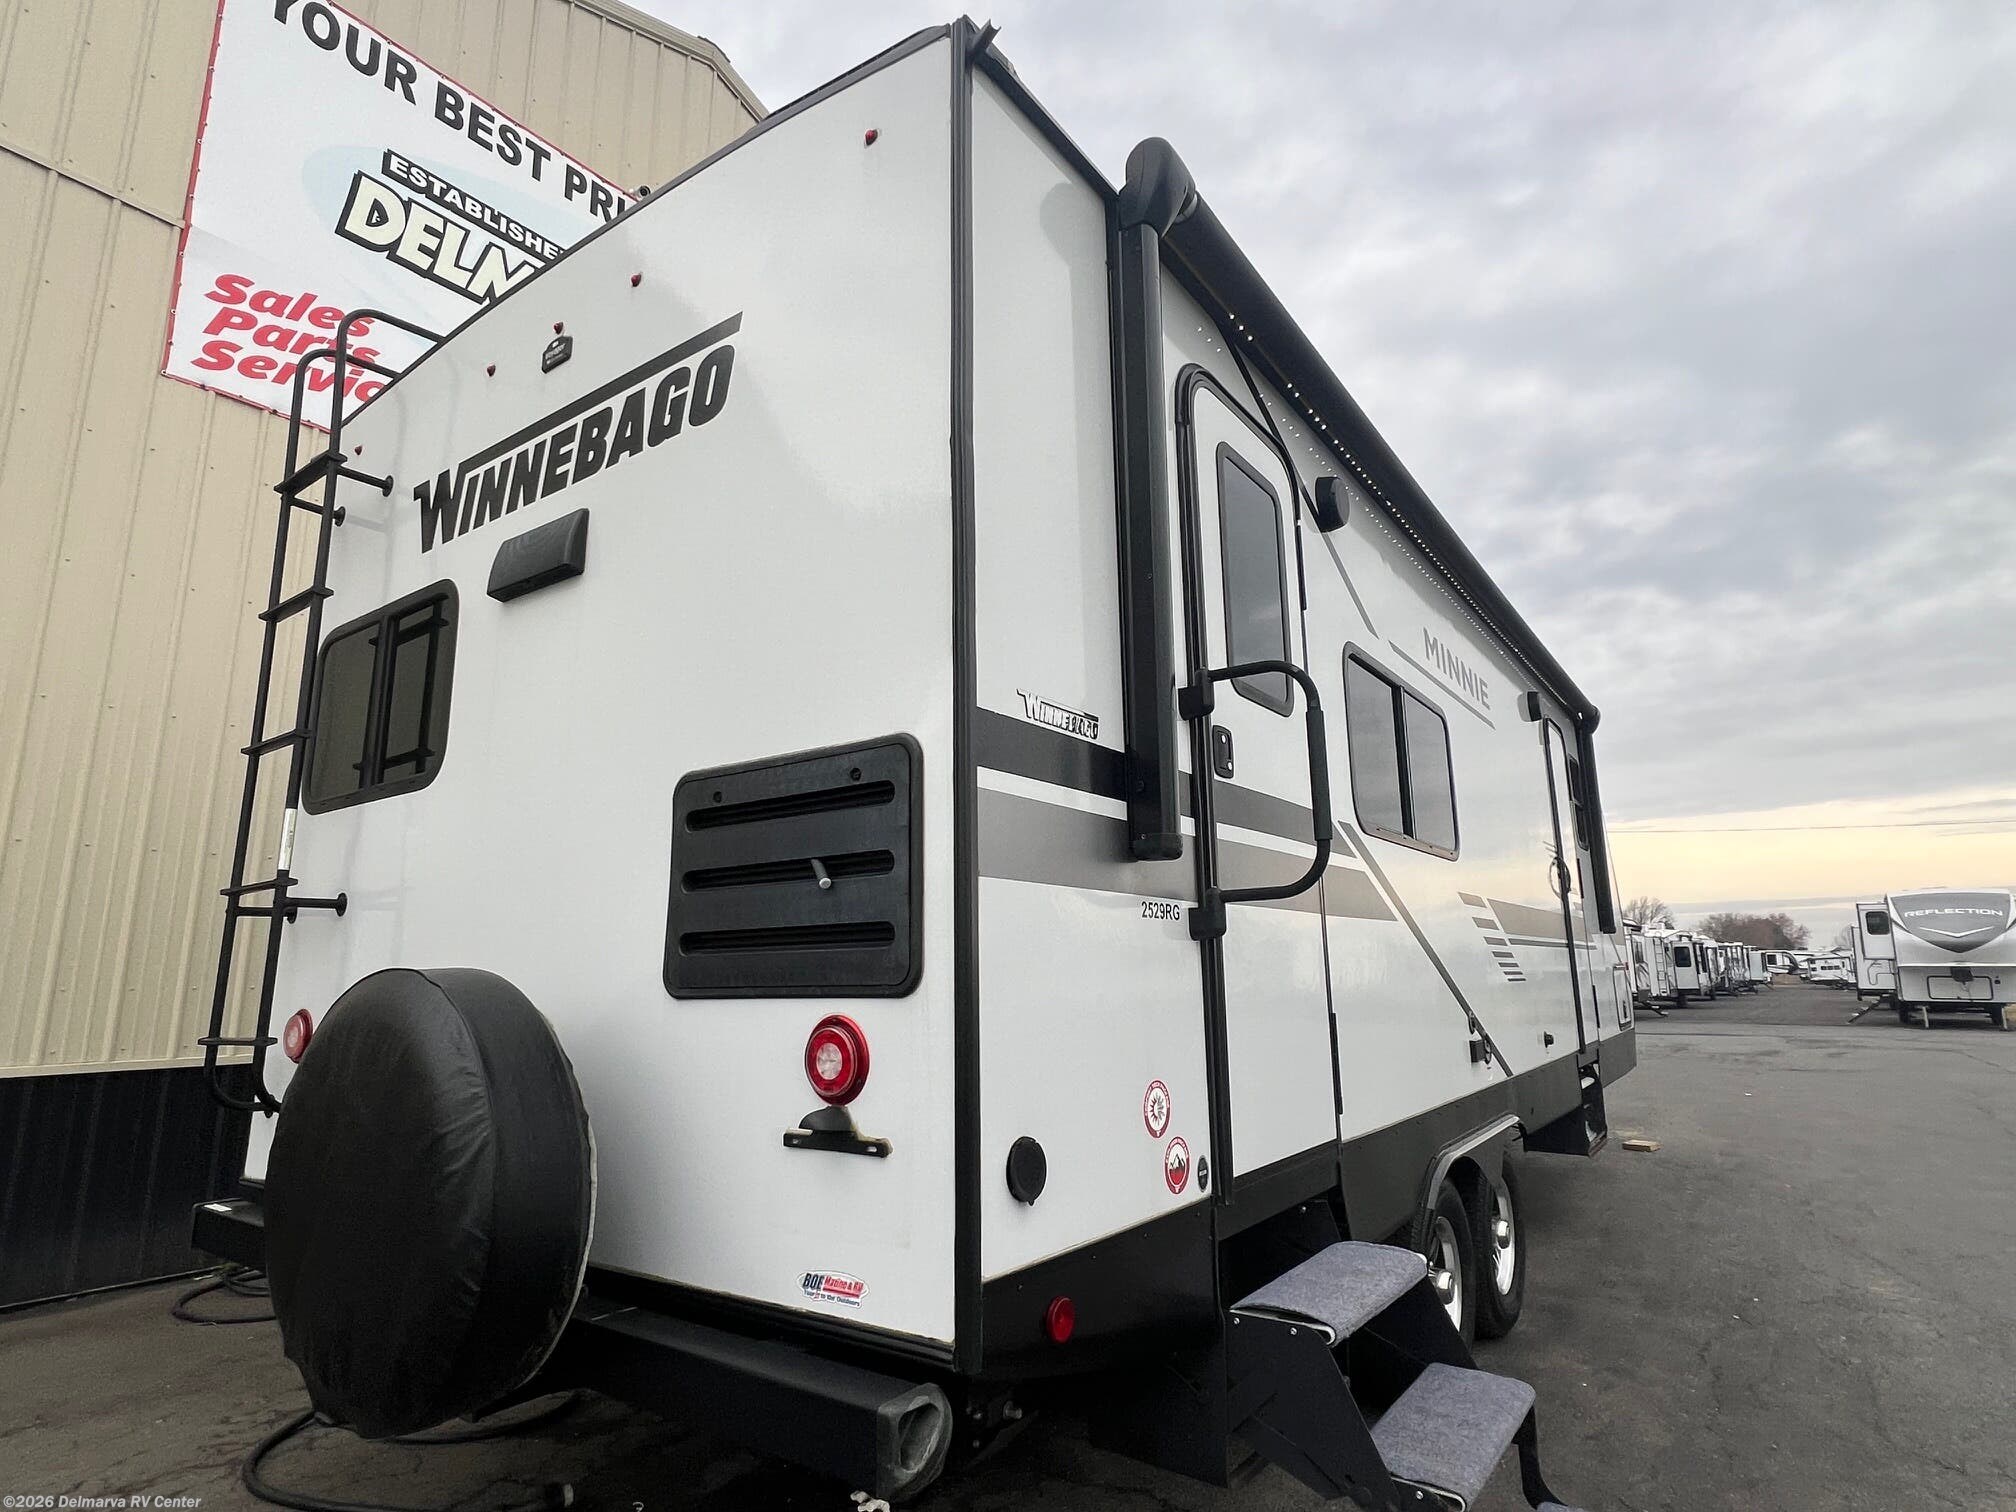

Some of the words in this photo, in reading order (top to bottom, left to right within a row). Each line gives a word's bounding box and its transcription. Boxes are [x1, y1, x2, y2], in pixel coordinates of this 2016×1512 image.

[435, 81, 551, 182] BEST
[203, 307, 381, 365] Parts
[204, 274, 375, 337] Sales
[413, 342, 736, 554] WINNEBAGO
[1423, 627, 1491, 711] MINNIE
[1141, 901, 1181, 921] 2529RG
[1904, 908, 2004, 918] REFLECTION
